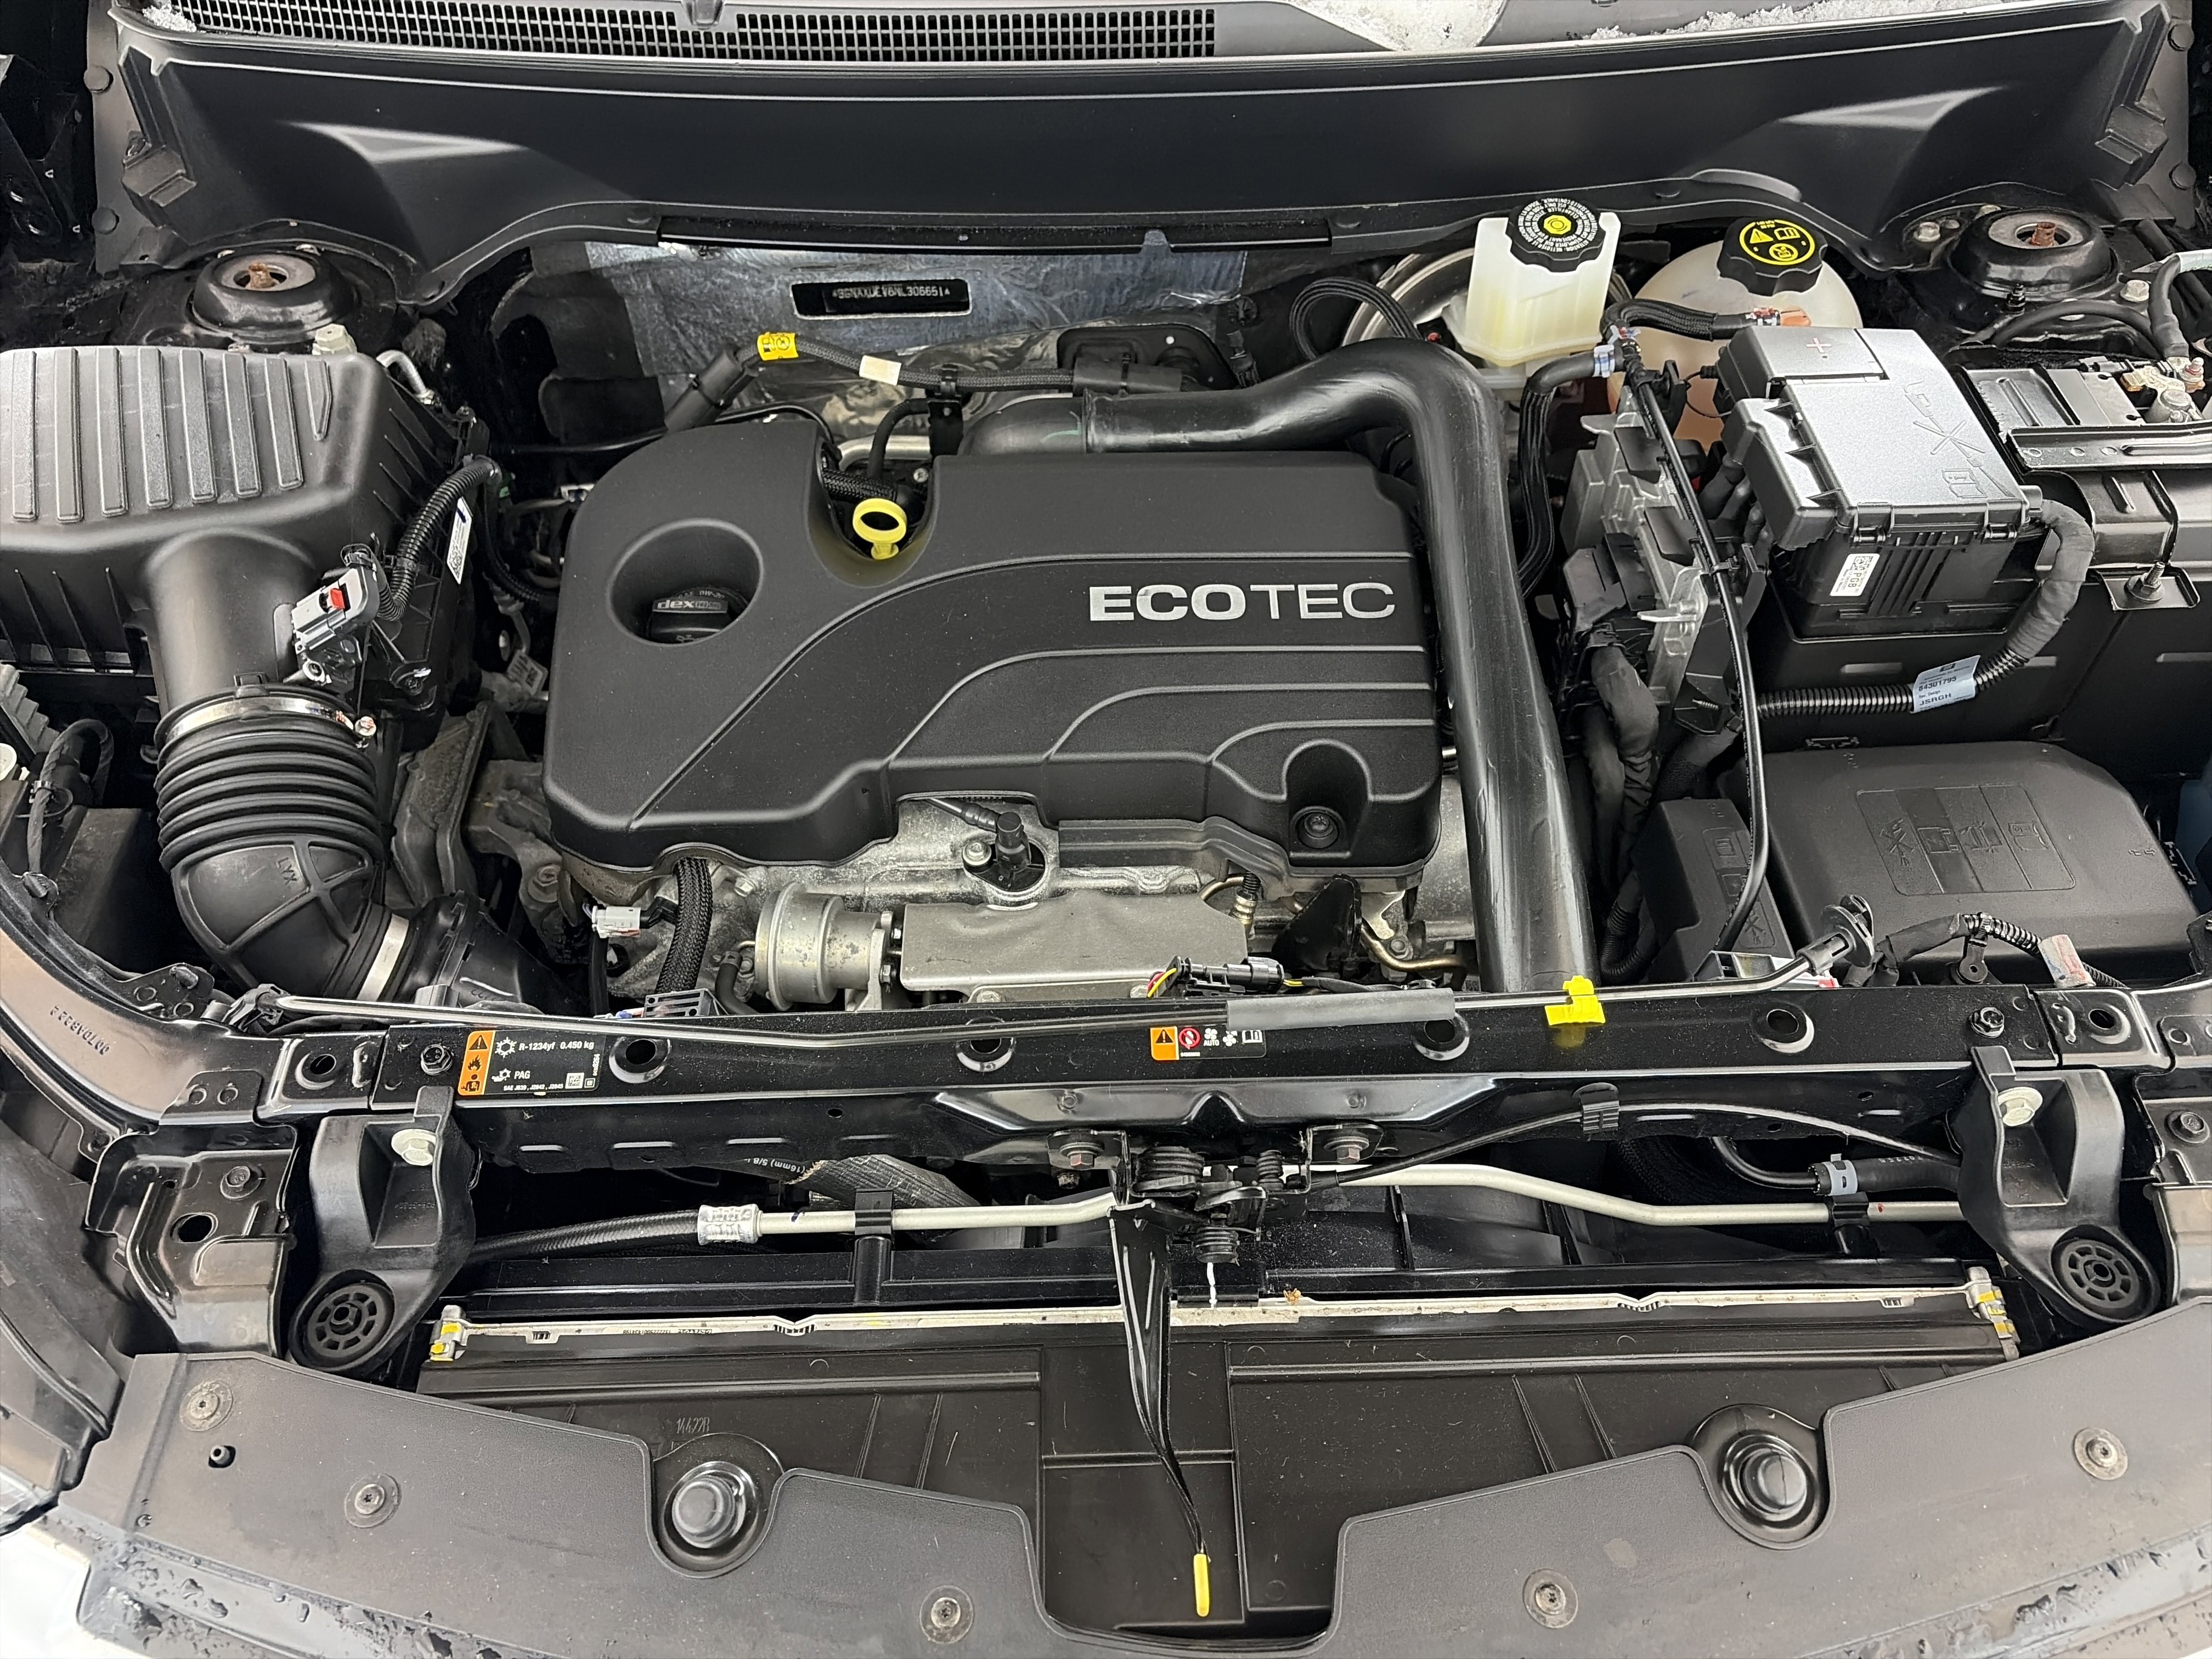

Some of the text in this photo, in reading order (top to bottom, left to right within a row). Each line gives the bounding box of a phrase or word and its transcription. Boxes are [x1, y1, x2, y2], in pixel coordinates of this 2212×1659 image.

[1848, 573, 1863, 588] PGB
[657, 599, 721, 610] dexos
[1089, 582, 1396, 621] ECOTEC
[1919, 693, 1951, 706] JSRGH
[275, 856, 297, 885] LYX
[518, 1041, 595, 1052] R-1234yf 0.450 kg
[514, 1070, 531, 1079] PAG
[753, 1157, 769, 1166] 5/8
[770, 1159, 806, 1174] (16mm)
